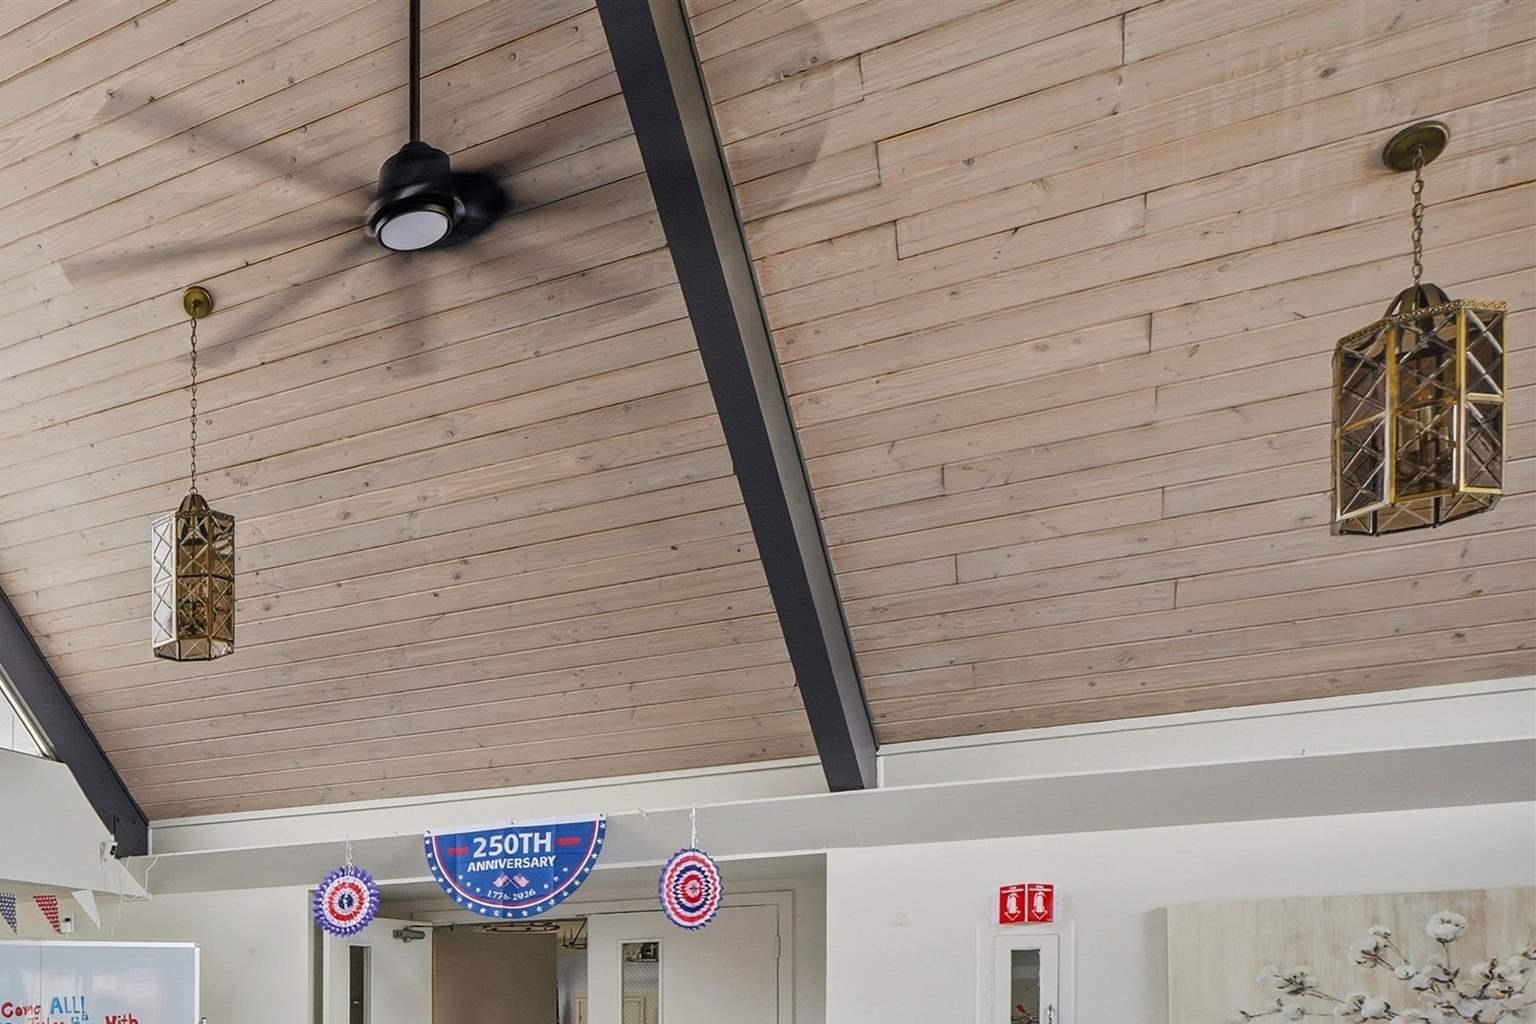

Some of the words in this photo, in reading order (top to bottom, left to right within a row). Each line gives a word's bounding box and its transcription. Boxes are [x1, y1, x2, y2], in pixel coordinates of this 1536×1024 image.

[472, 831, 552, 858] 250TH
[466, 855, 557, 873] ANNIVERSARY
[50, 995, 85, 1014] ALL!
